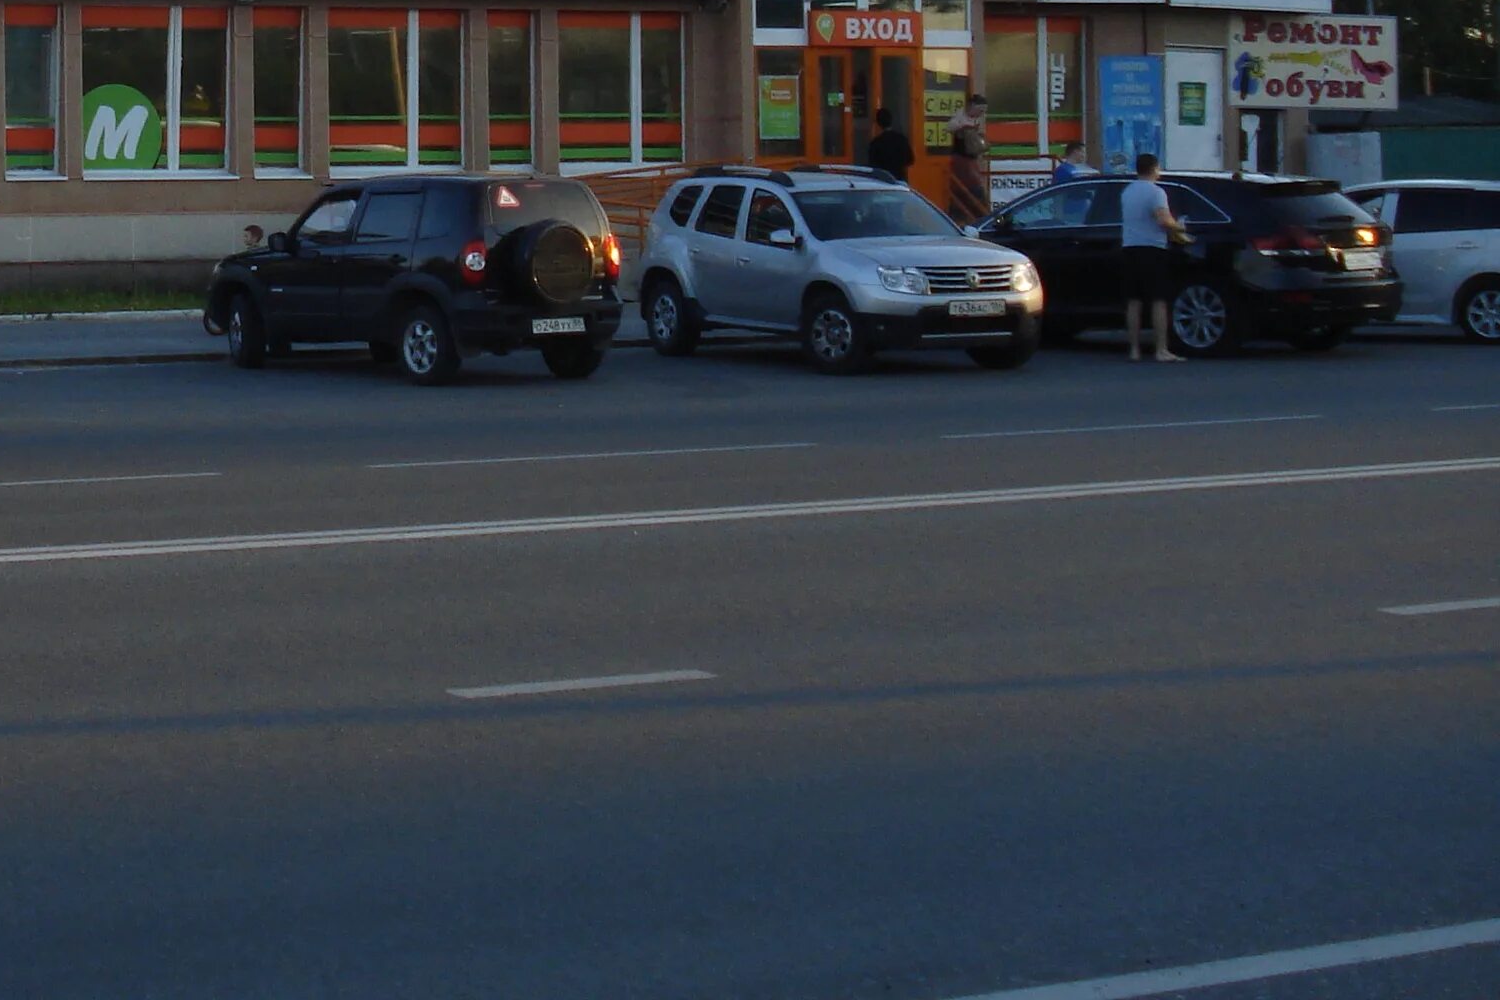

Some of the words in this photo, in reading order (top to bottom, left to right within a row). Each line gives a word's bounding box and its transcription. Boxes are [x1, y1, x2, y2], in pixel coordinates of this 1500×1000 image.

[846, 17, 913, 42] ВХОД
[1243, 14, 1382, 46] Ремонт
[1266, 71, 1364, 104] обуви
[926, 98, 964, 112] СЫР
[85, 105, 149, 160] М
